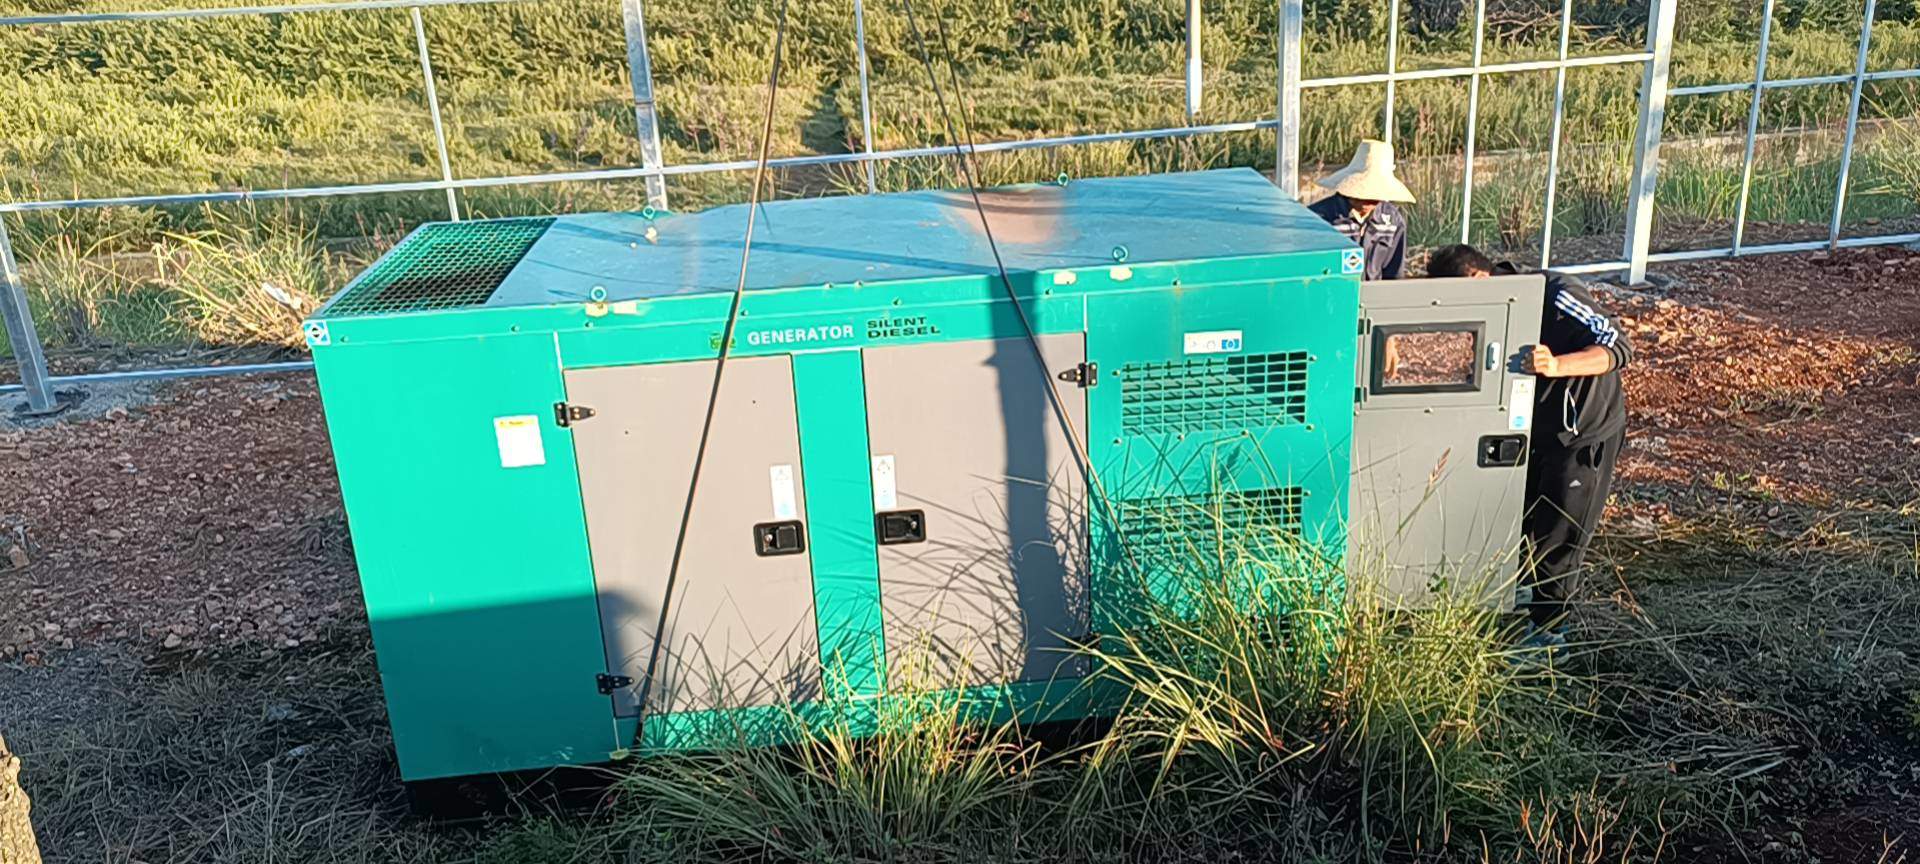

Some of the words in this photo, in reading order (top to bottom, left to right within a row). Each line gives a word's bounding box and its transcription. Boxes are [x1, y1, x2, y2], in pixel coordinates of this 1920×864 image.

[867, 317, 927, 328] SILENT
[747, 325, 854, 345] GENERATOR
[867, 326, 941, 338] DIESEL
